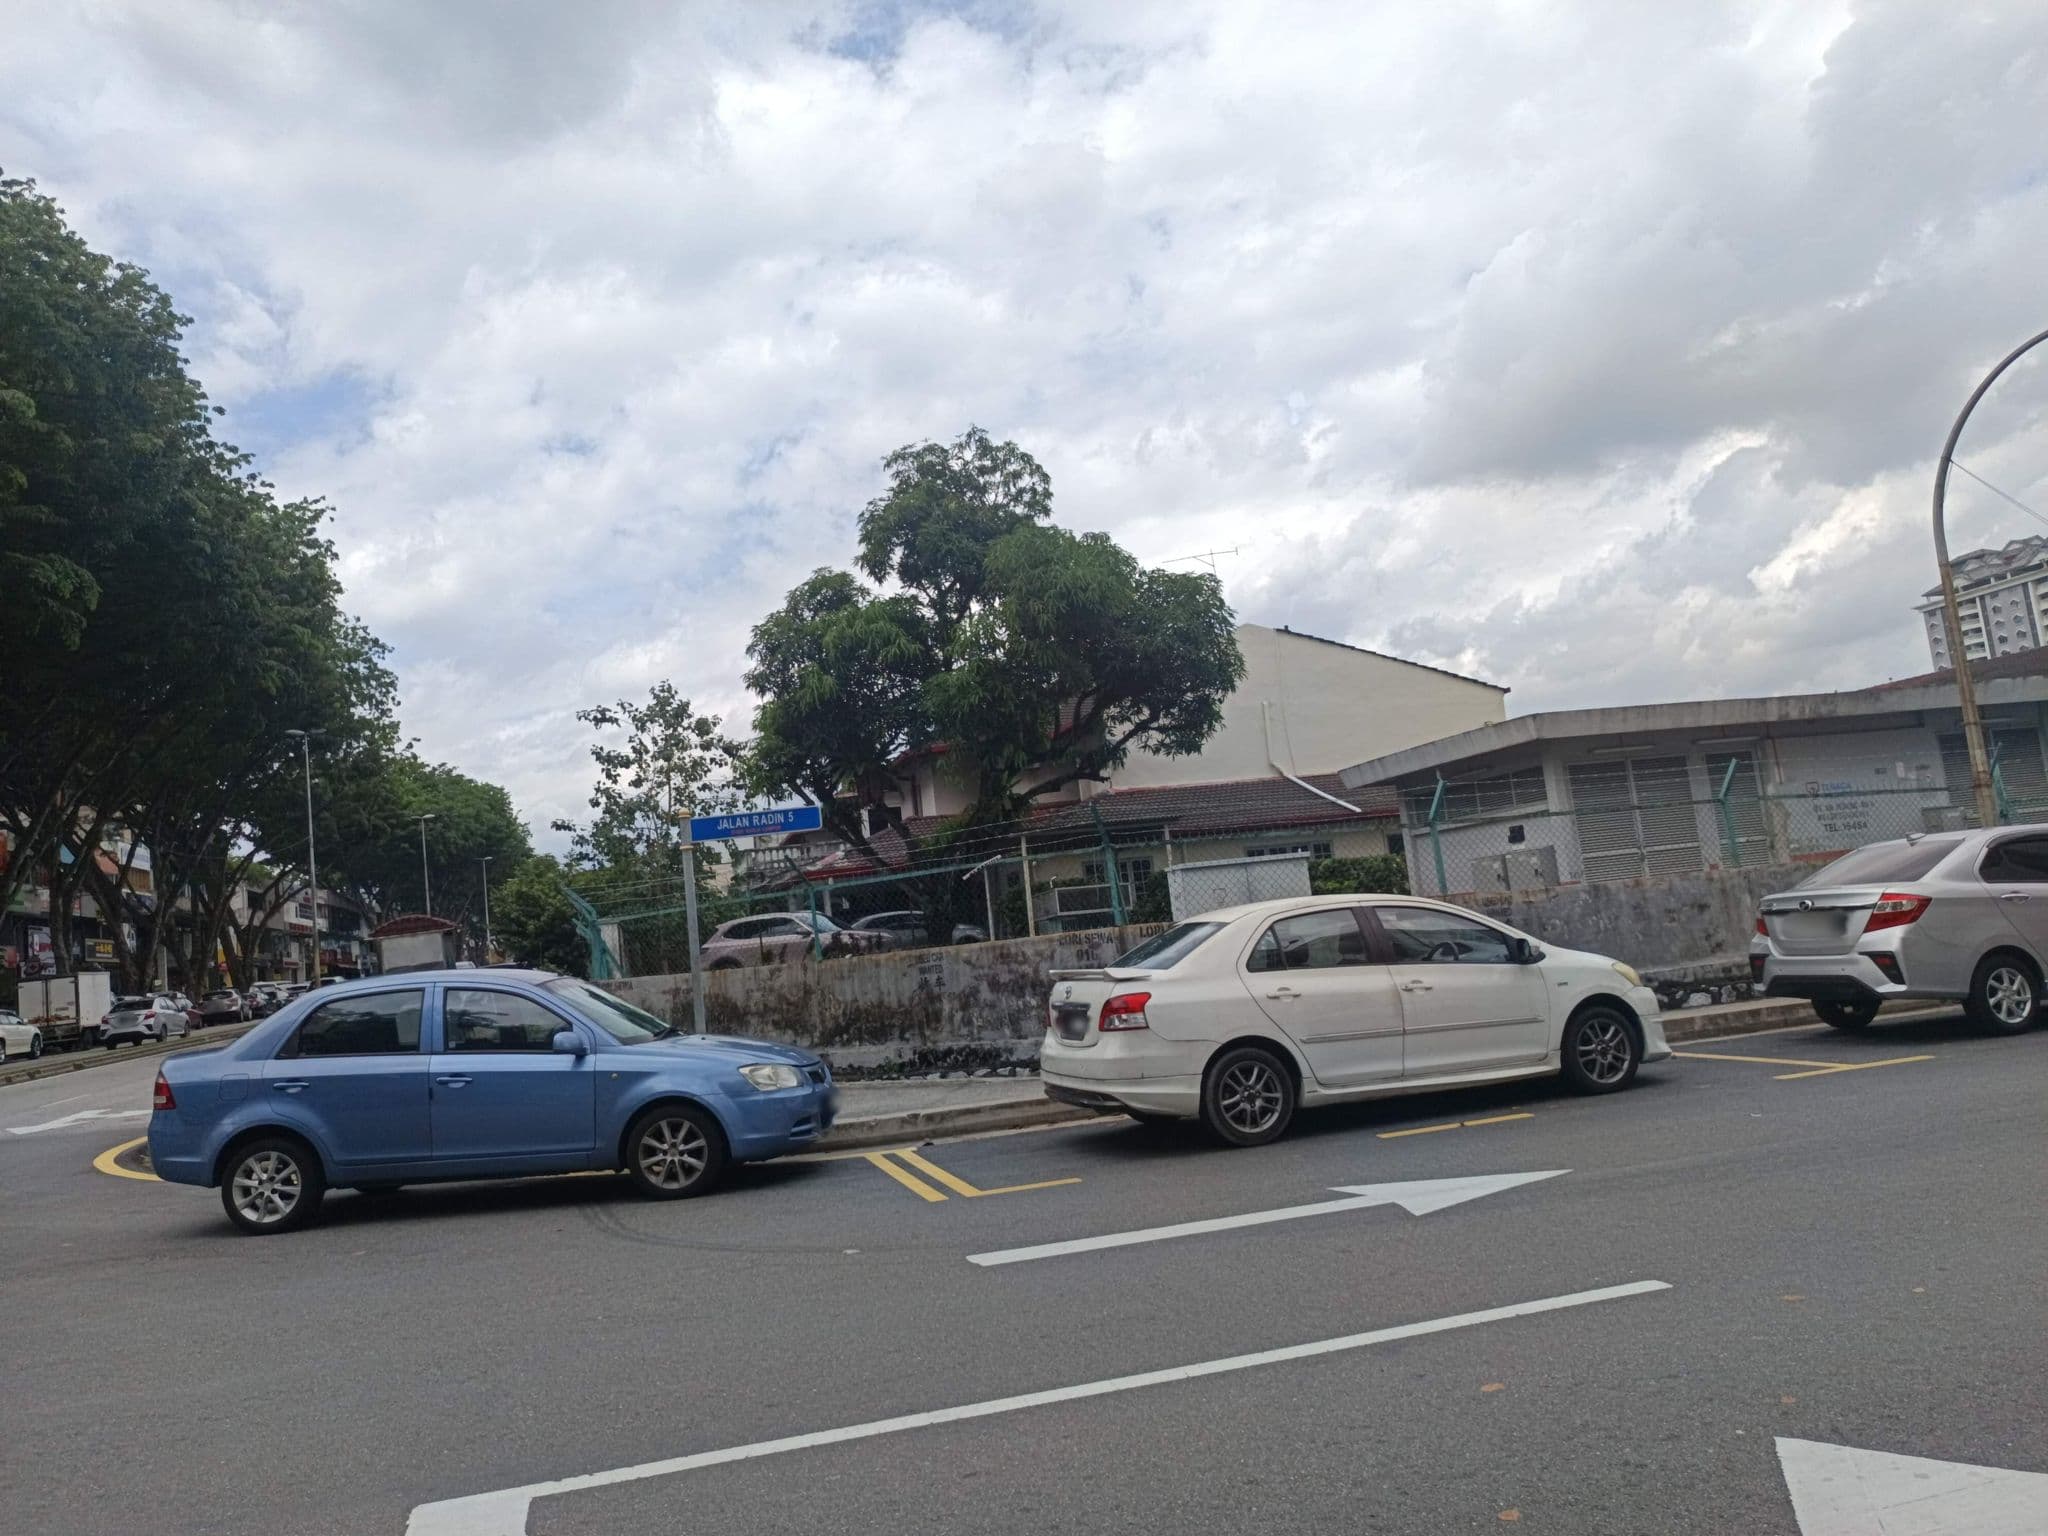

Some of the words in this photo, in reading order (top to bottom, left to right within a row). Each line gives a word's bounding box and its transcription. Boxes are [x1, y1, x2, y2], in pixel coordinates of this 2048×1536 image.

[717, 816, 749, 830] JALAN
[752, 813, 784, 826] RADIN
[787, 812, 794, 822] 5
